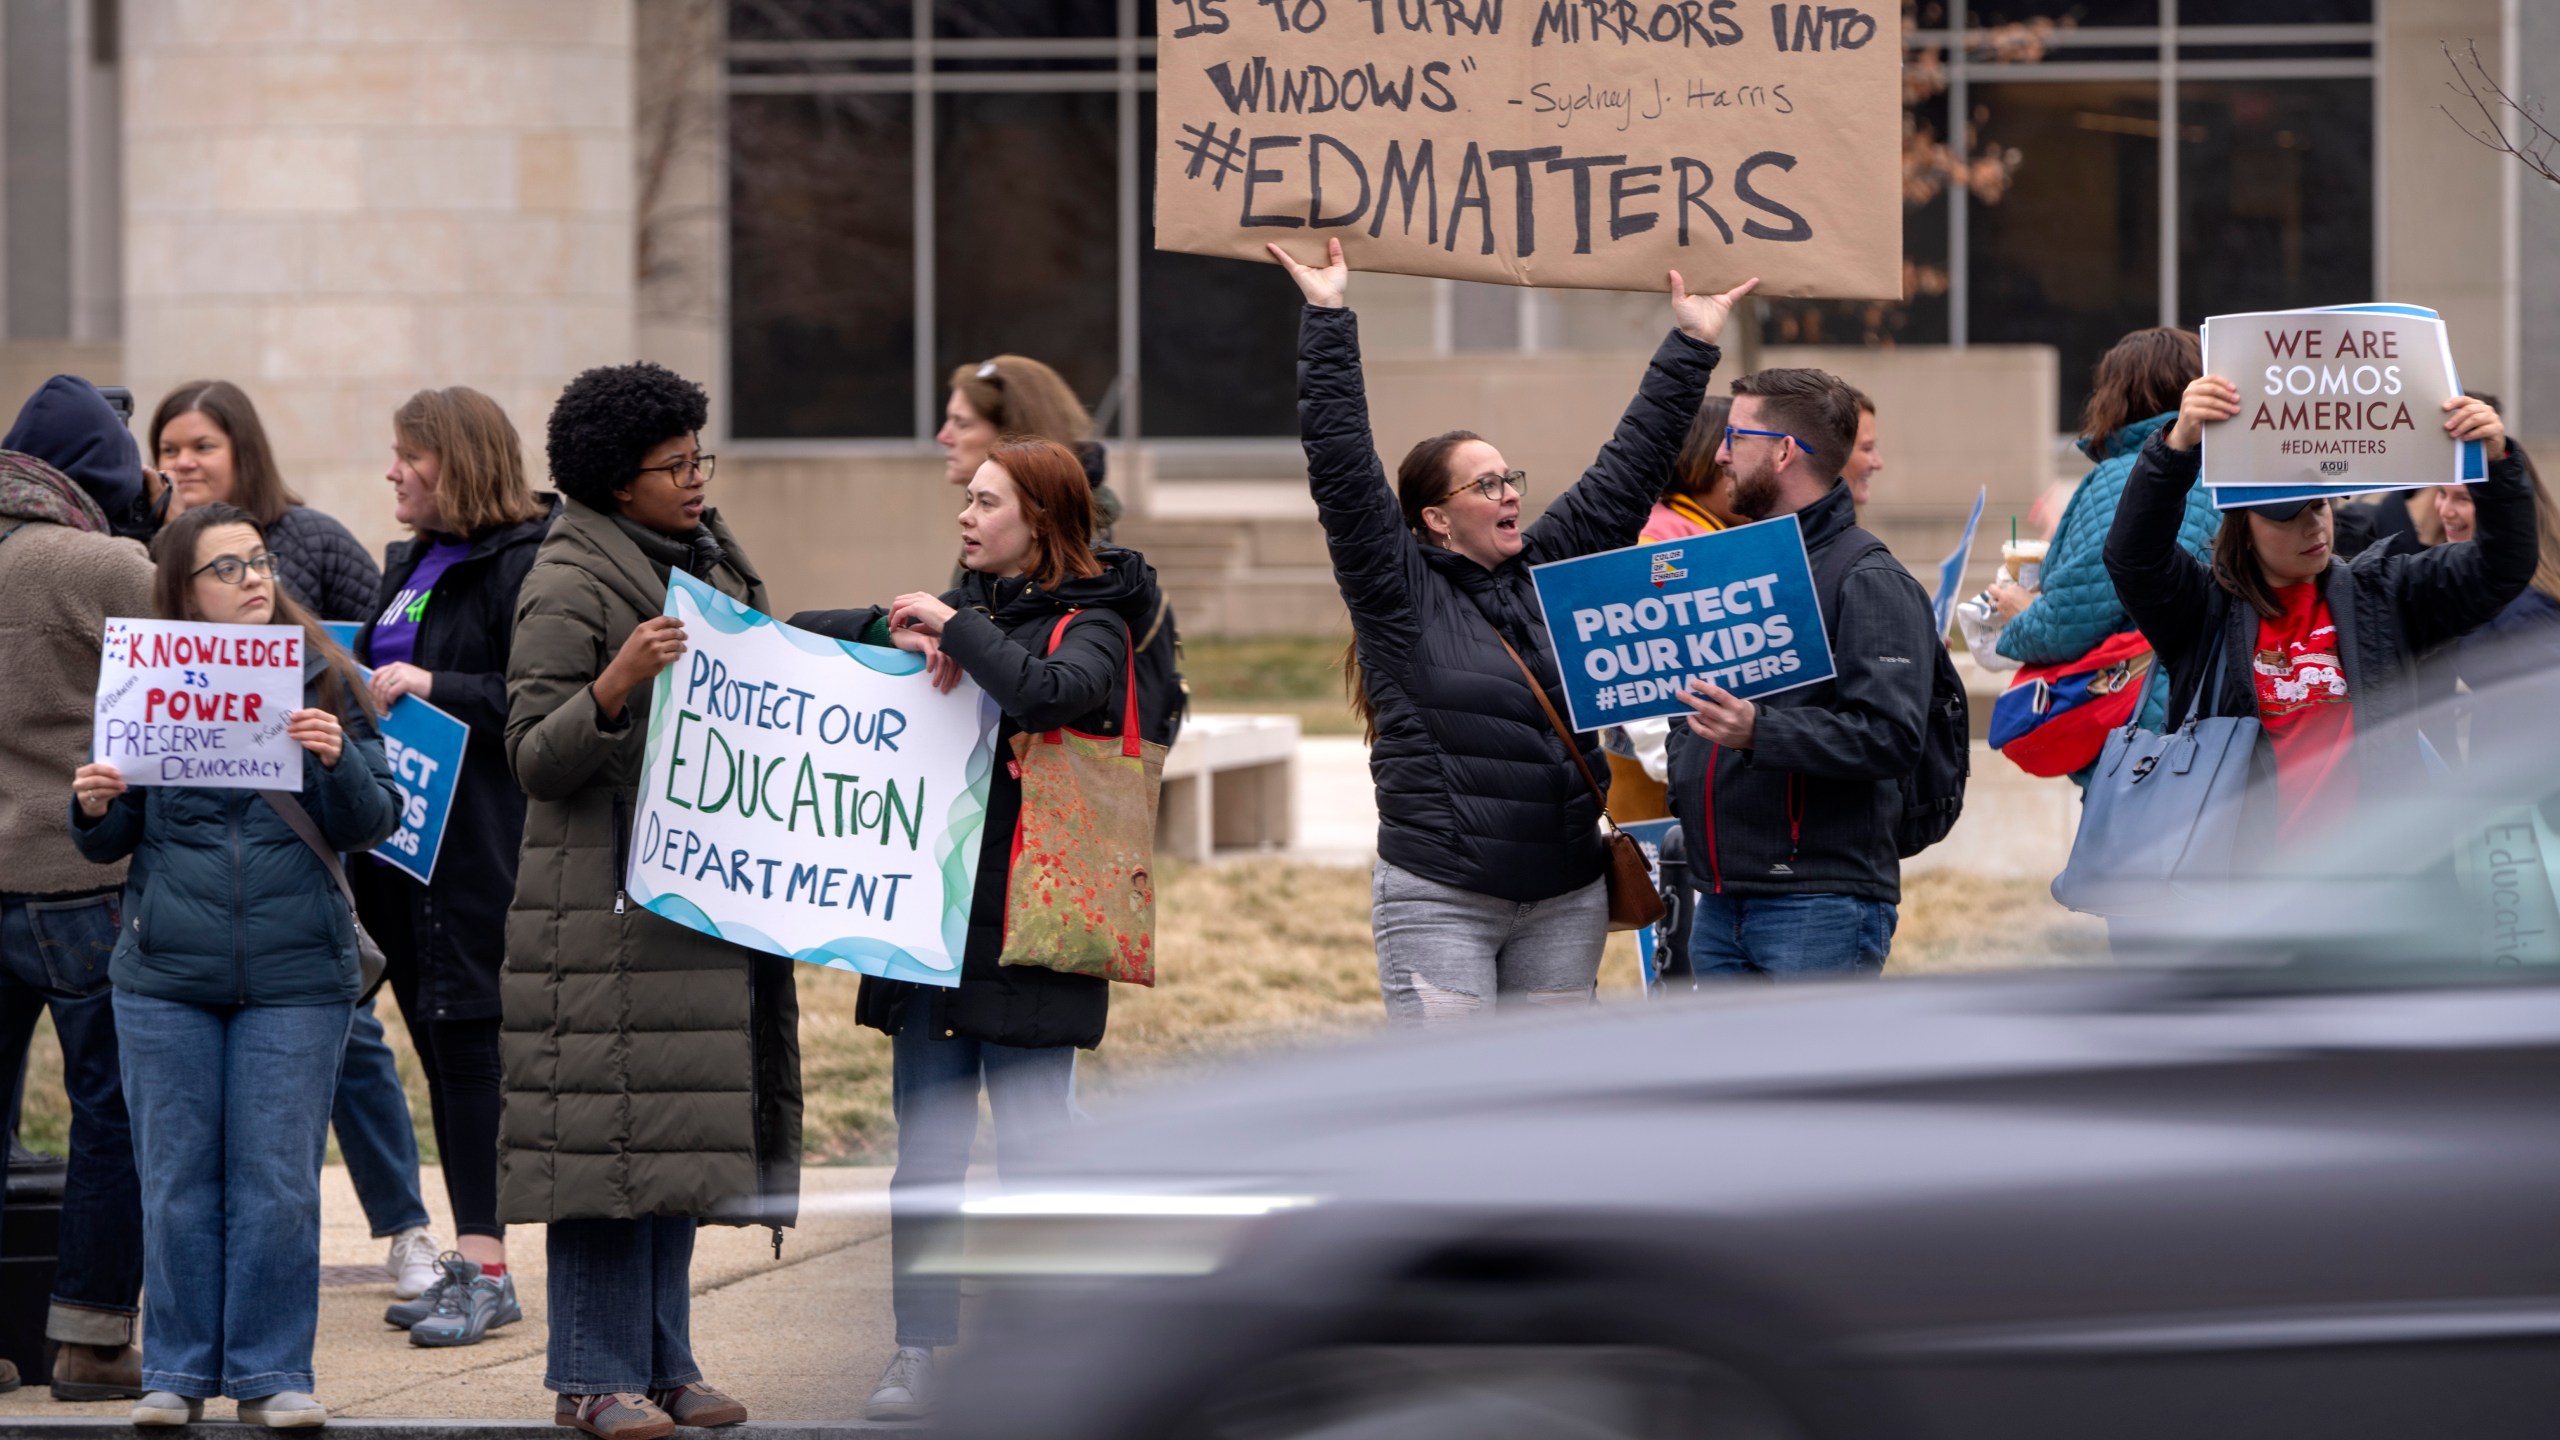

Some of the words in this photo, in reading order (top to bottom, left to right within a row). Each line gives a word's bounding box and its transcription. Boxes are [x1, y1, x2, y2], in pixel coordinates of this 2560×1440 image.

[1174, 0, 1229, 38] IS
[1258, 0, 1326, 33] TO
[1367, 0, 1503, 36] TURN
[1532, 0, 1743, 47] MIRRORS
[1771, 3, 1877, 52] INTO
[1642, 78, 1671, 119] J.
[1687, 79, 1793, 113] Harris
[1175, 121, 1813, 258] #EDMATTERS
[2265, 330, 2321, 359] WE
[2335, 330, 2399, 359] ARE
[2264, 365, 2402, 396] SOMOS
[2250, 401, 2415, 431] AMERICA
[2281, 440, 2387, 454] #EDMATTERS
[1572, 573, 1778, 642] PROTECT
[128, 633, 299, 668] KNOWLEDGE
[1584, 636, 1684, 682] OUR
[1686, 614, 1794, 667] KIDS
[184, 670, 209, 688] IS
[1595, 649, 1802, 711] #EDMATTERS
[145, 688, 263, 723] POWER
[687, 649, 815, 735] PROTECT
[819, 704, 907, 752] OUR
[106, 719, 226, 757] PRESERVE
[160, 756, 285, 781] DEMOCRACY
[384, 734, 439, 790] ECT
[666, 710, 924, 851] EDUCATION
[642, 811, 912, 921] DEPARTMENT
